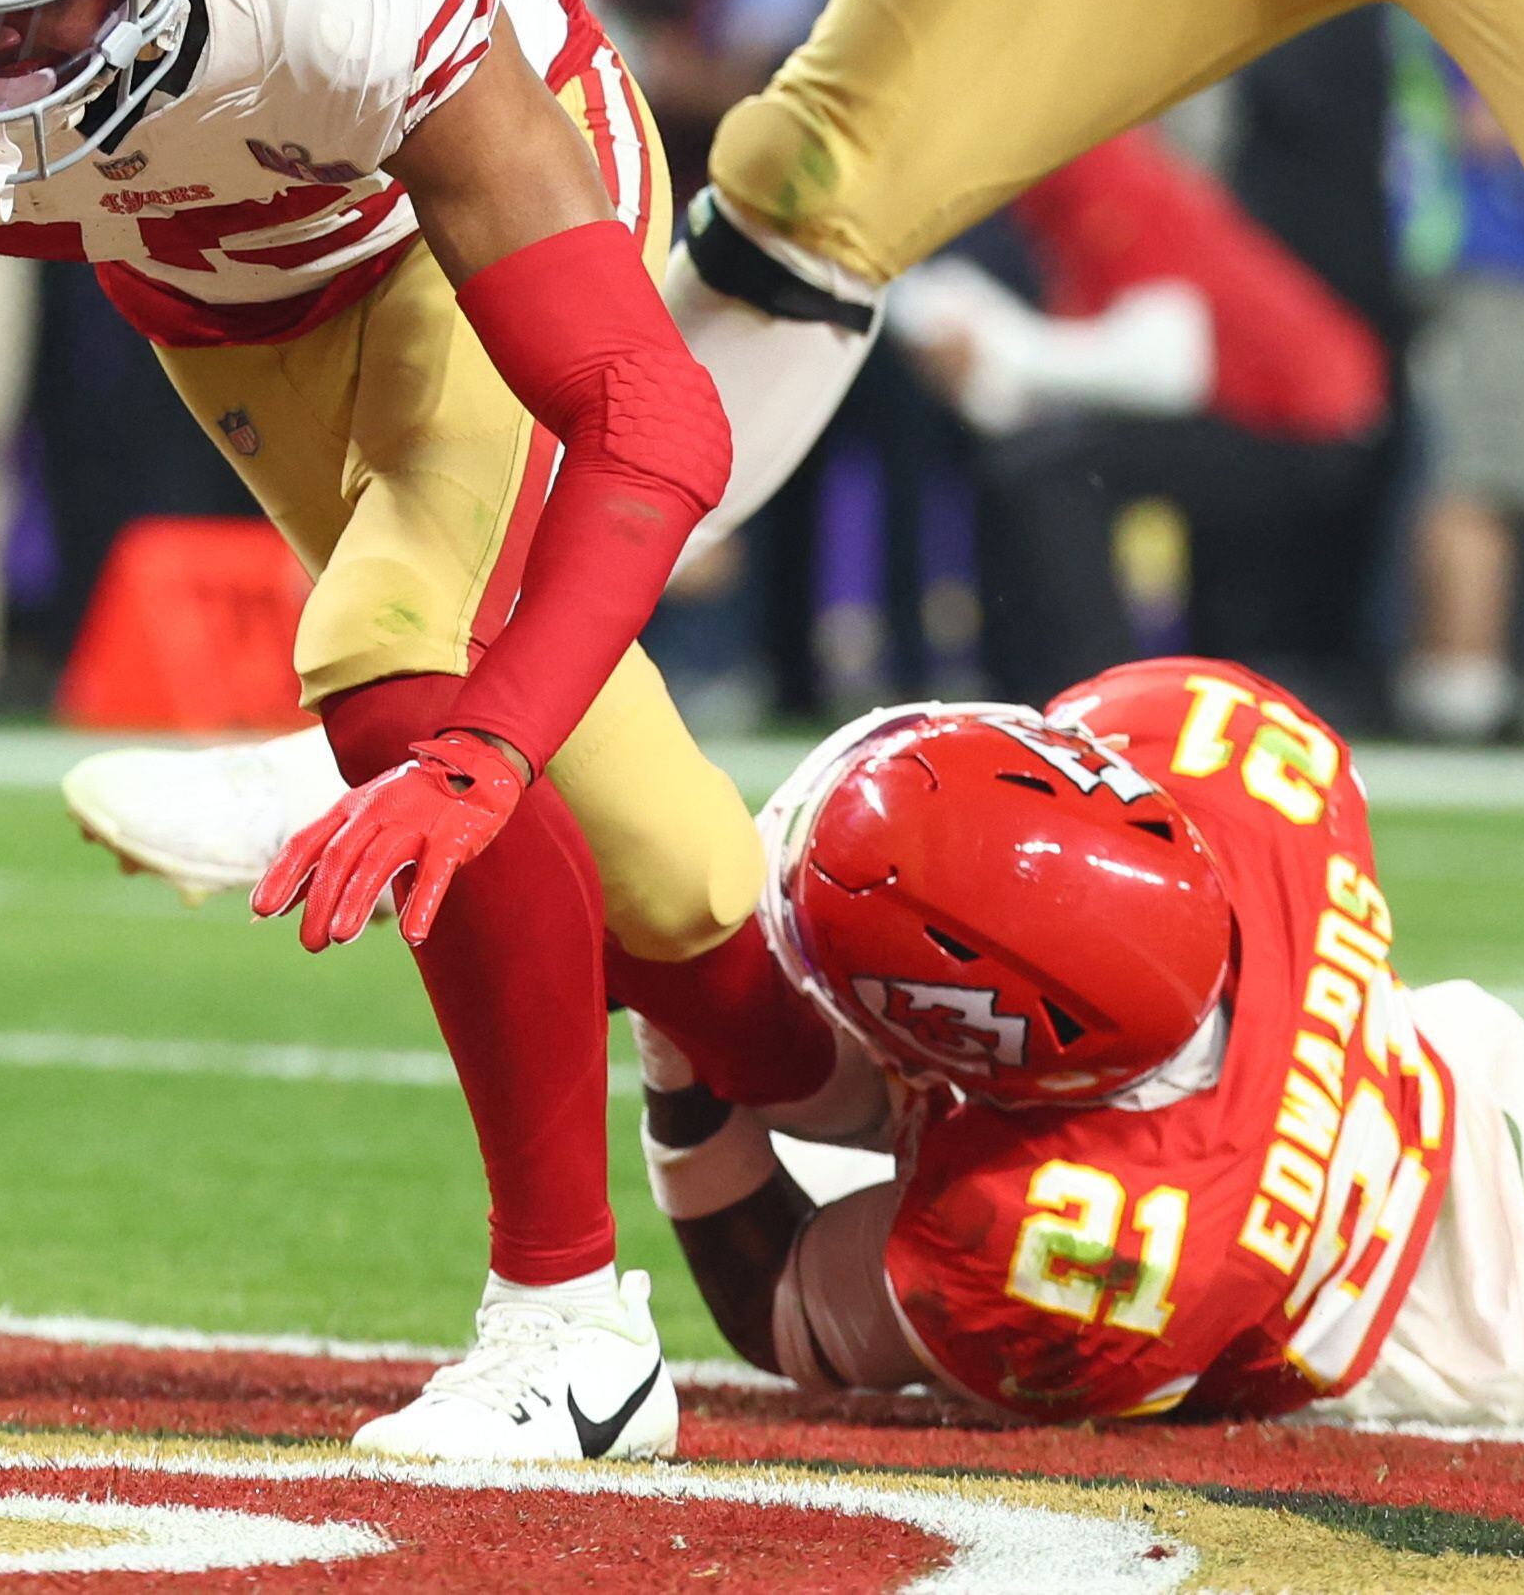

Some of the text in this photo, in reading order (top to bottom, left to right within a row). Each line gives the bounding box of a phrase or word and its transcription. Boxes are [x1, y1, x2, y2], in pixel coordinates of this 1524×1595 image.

[1169, 675, 1340, 825] 21
[1238, 854, 1392, 1275] EDWARDS
[1005, 1159, 1190, 1338] 21
